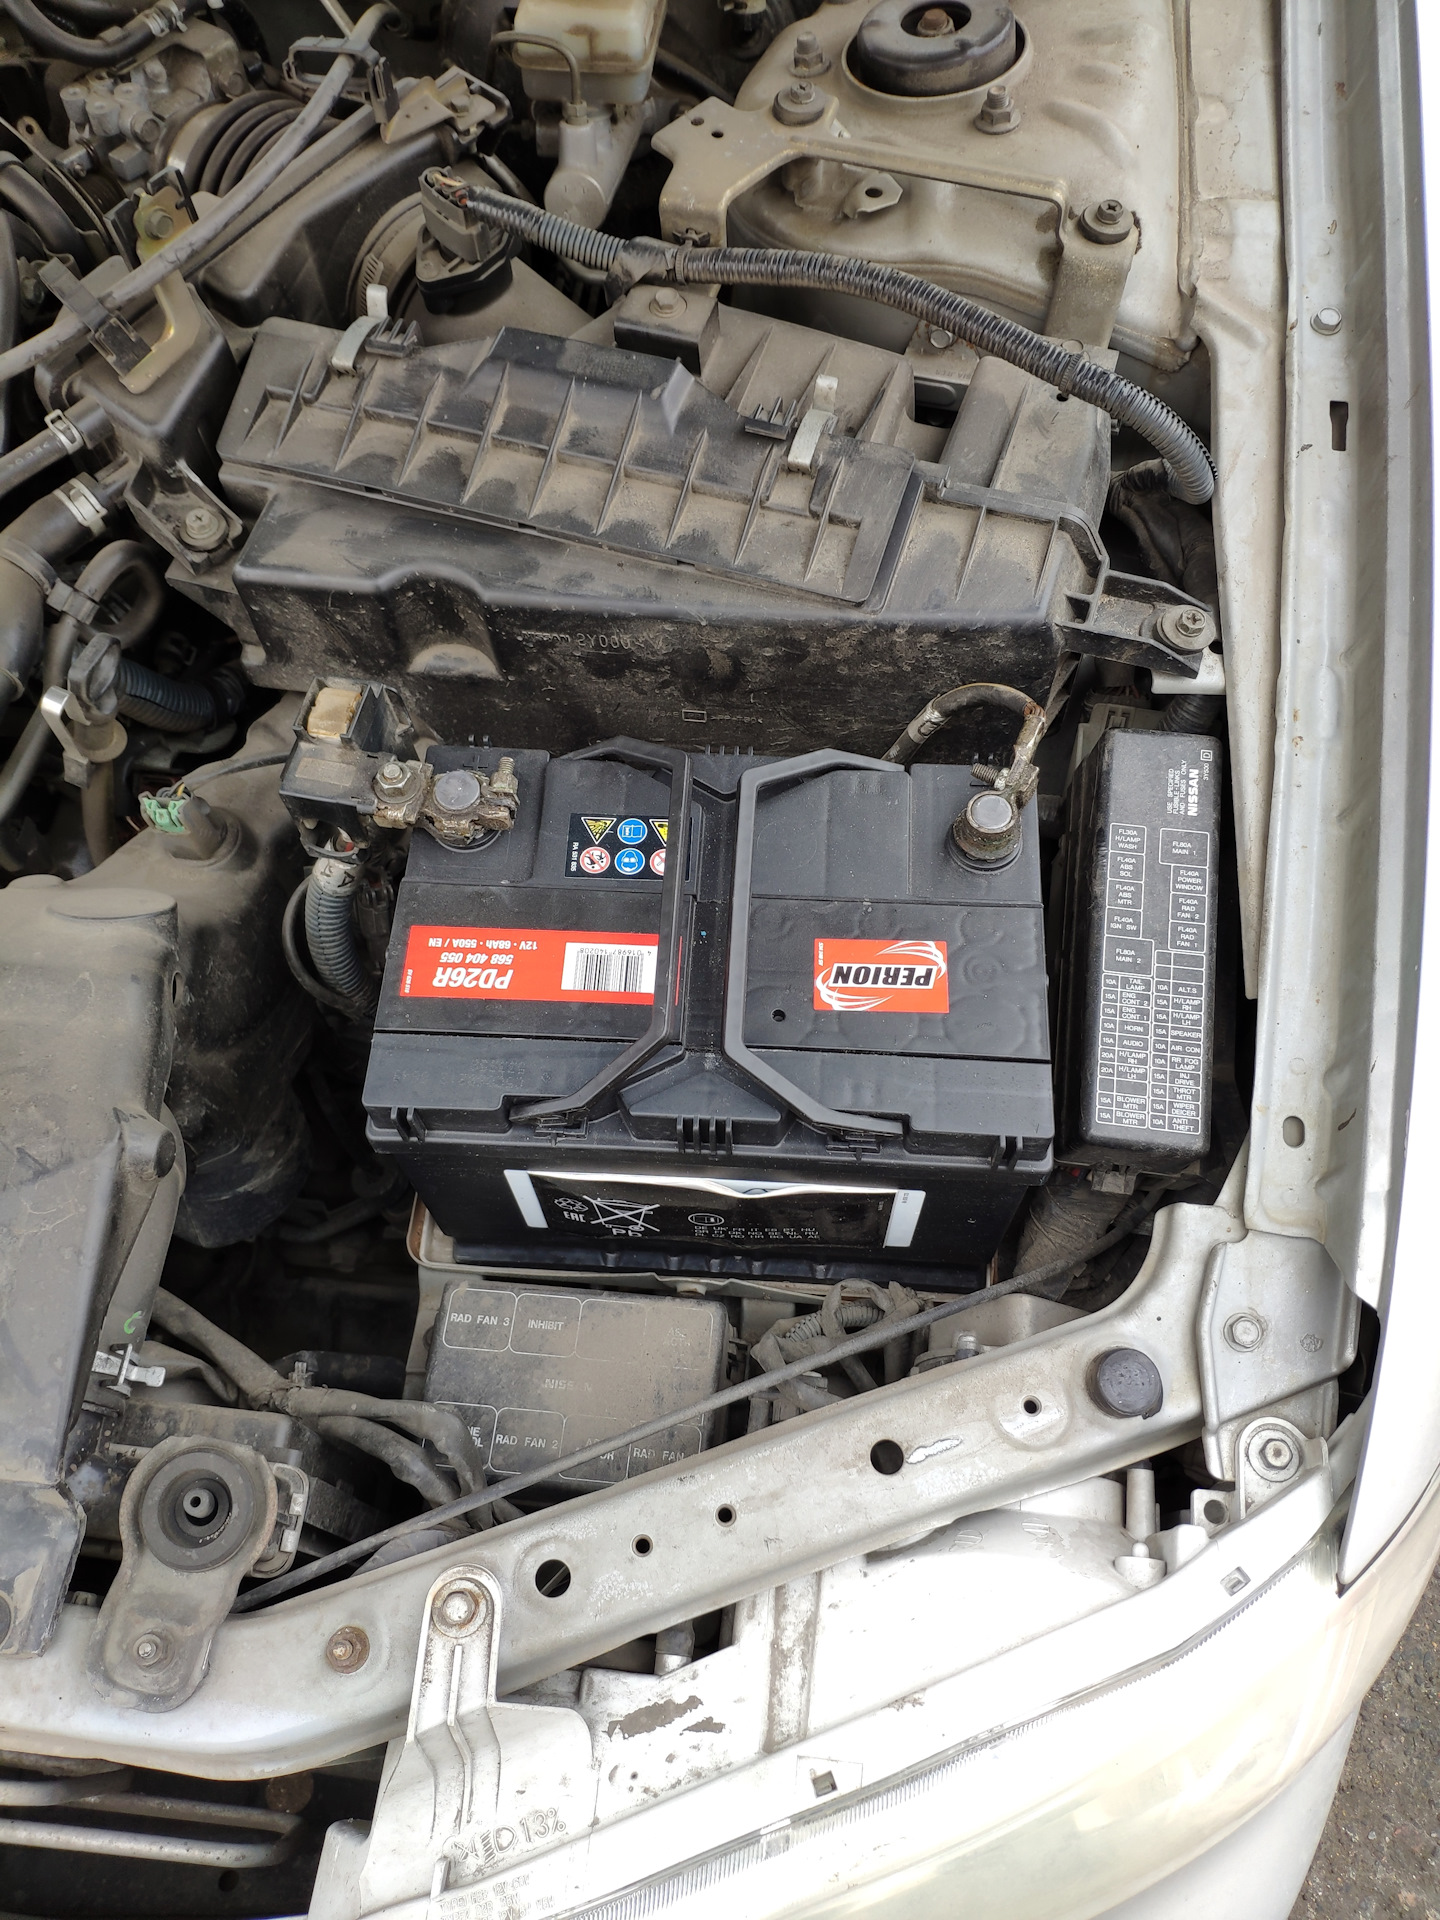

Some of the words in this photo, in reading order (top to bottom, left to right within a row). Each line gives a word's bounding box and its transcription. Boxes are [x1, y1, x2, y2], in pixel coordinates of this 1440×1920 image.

[1187, 768, 1200, 816] NISSAN
[1118, 828, 1138, 836] FL30A
[1118, 842, 1137, 850] WASH
[1117, 856, 1136, 864] FL40A
[1120, 870, 1132, 878] SOL
[1178, 876, 1202, 884] POWER
[1175, 883, 1204, 891] WINDOW
[1178, 926, 1197, 934] FL40A
[428, 938, 442, 947] EN
[452, 938, 477, 948] 550A
[486, 940, 511, 949] 68Ah
[519, 941, 538, 950] 12V
[1116, 948, 1135, 956] FL80A
[439, 952, 464, 963] 055
[465, 953, 489, 964] 404
[490, 954, 514, 965] 568
[432, 966, 514, 989] PD26R
[832, 966, 934, 986] PERION
[1122, 998, 1140, 1006] CONT
[1174, 998, 1201, 1006] H/LAMP
[1173, 1012, 1200, 1020] H/LAMP
[1170, 1030, 1201, 1038] SPEAKER
[1119, 1051, 1146, 1059] H/LAMP
[1118, 1066, 1146, 1074] H/LAMP
[1117, 1096, 1146, 1104] BLOWER
[1116, 1111, 1145, 1119] BLOWER
[450, 1312, 472, 1323] RAD
[477, 1315, 498, 1325] FAN
[503, 1318, 510, 1326] 3
[528, 1319, 564, 1330] INHIBIT
[495, 1435, 517, 1446] RAD
[524, 1437, 546, 1448] FAN
[552, 1441, 558, 1449] 2
[520, 1808, 566, 1842] 13%
